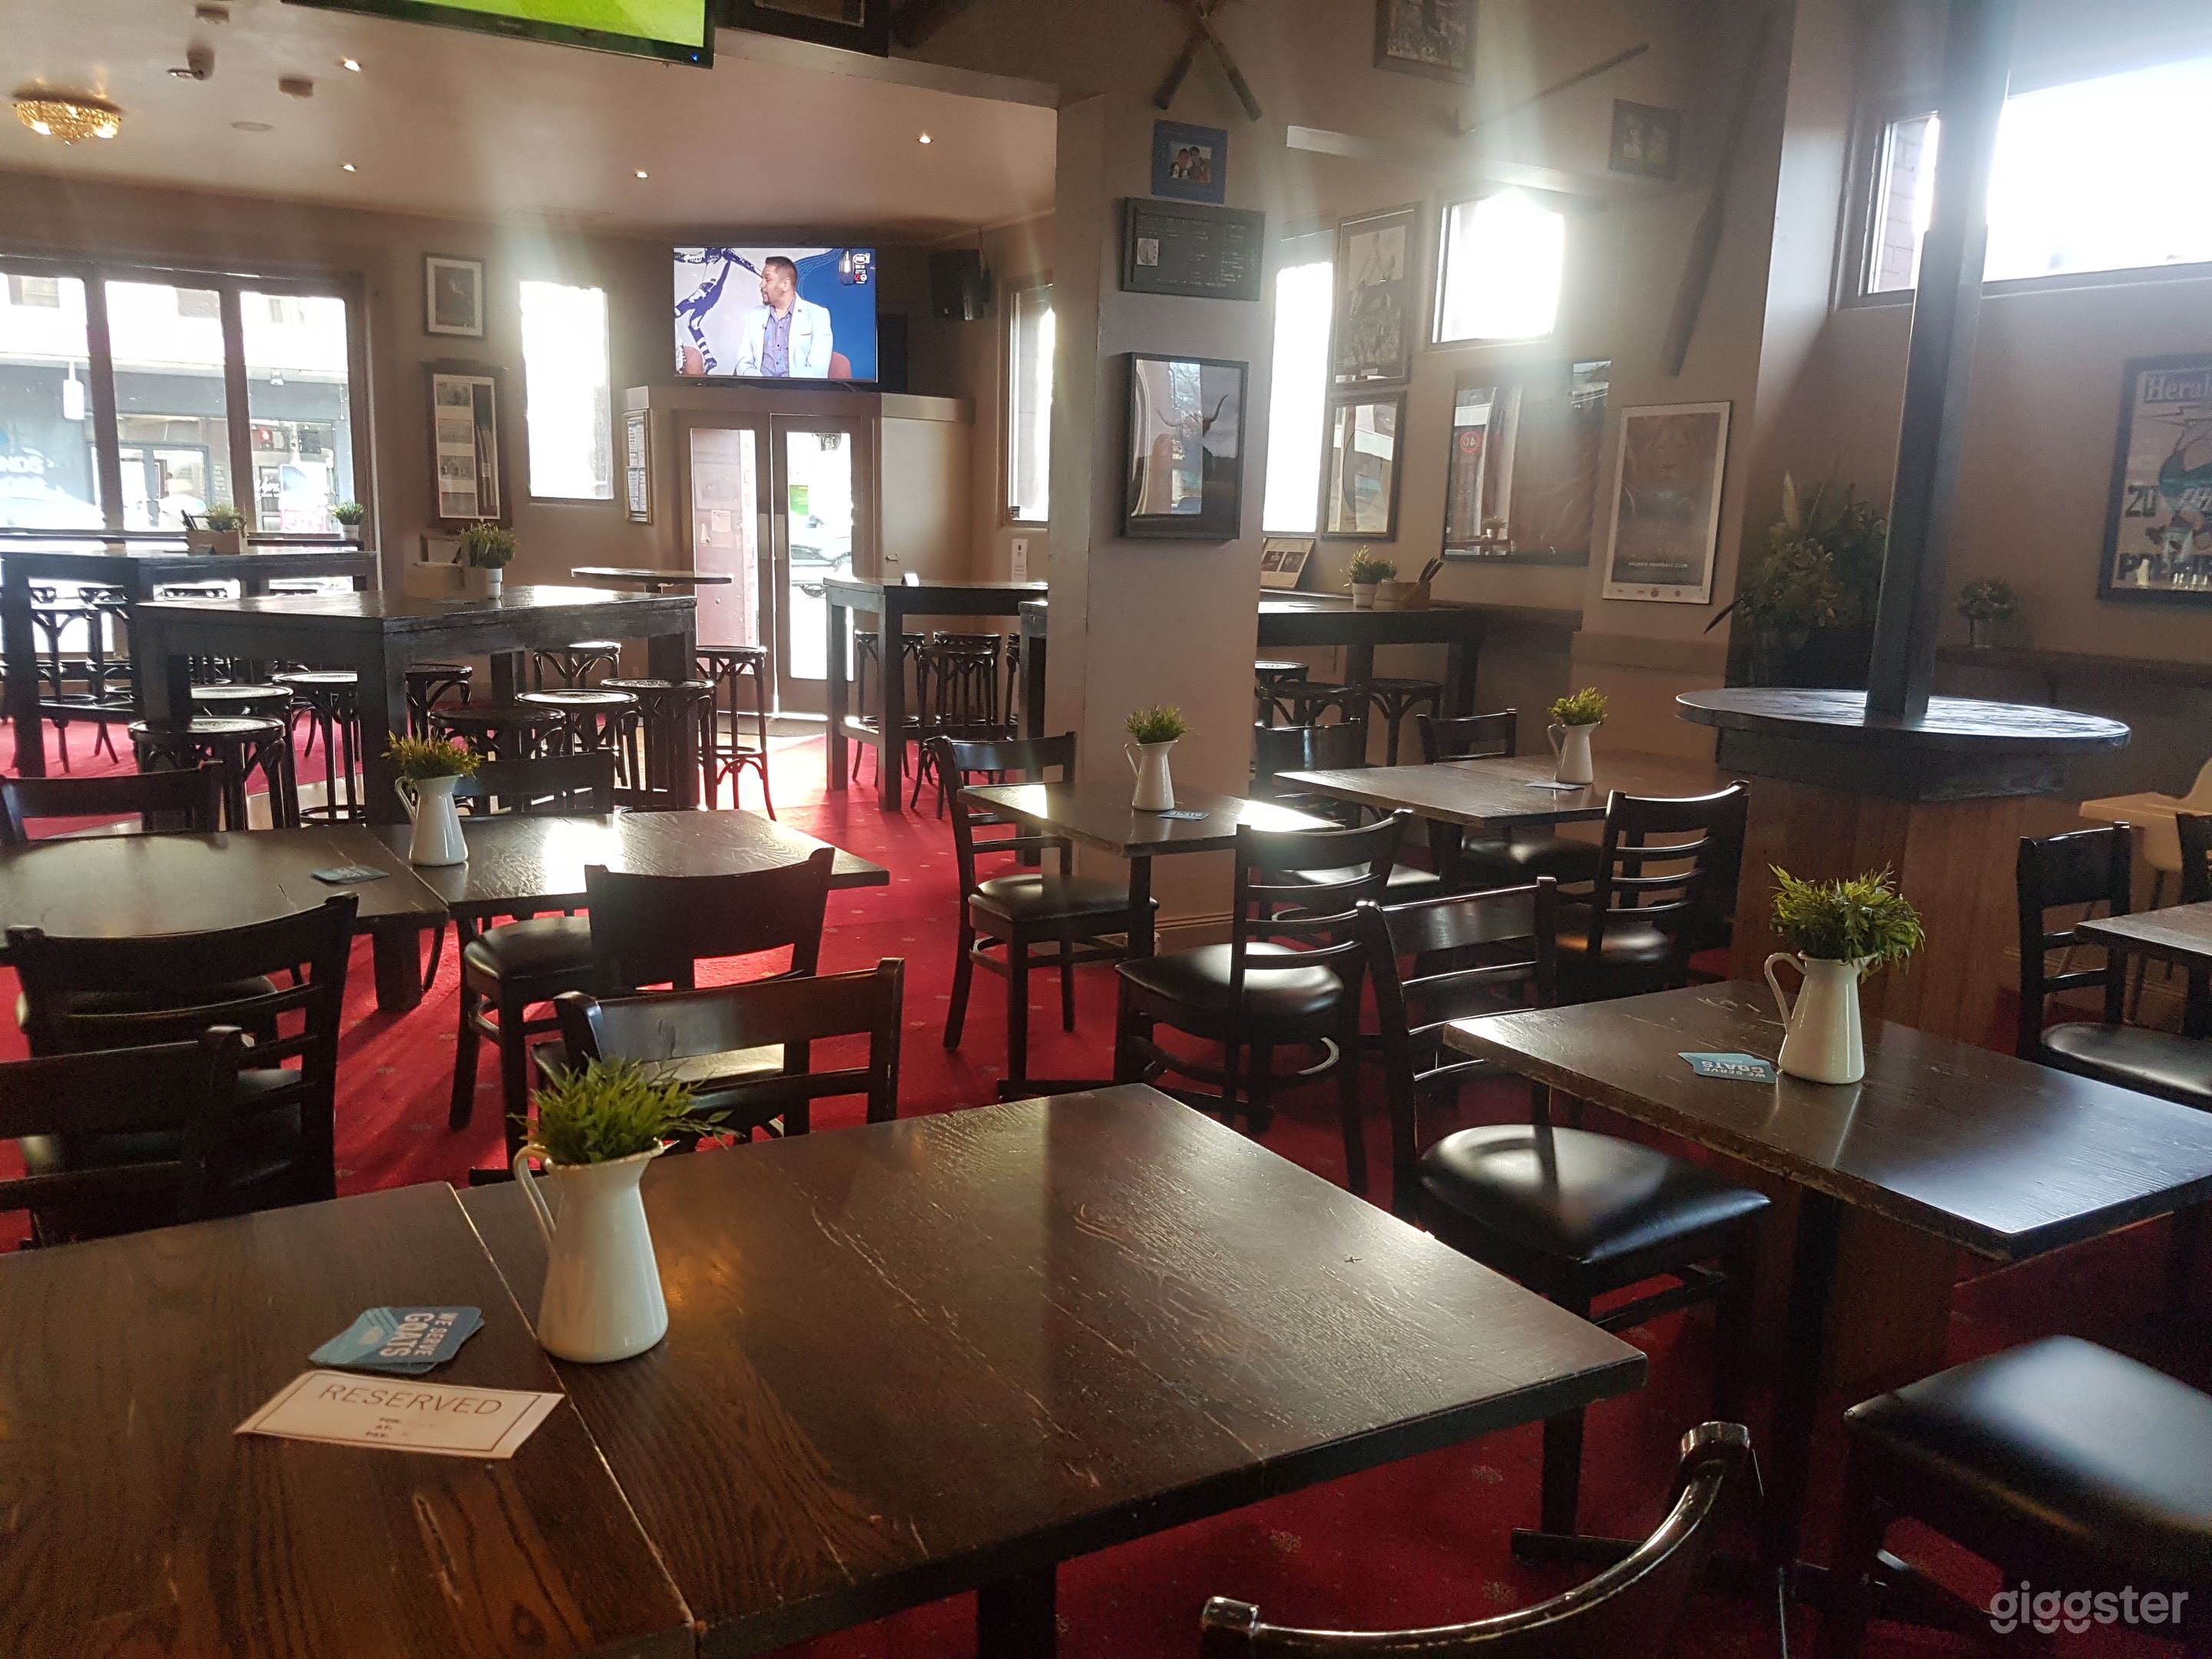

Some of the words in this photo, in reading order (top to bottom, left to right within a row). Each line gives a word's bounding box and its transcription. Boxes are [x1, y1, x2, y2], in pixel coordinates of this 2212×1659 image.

[1701, 1061, 1764, 1075] GOATS
[435, 1313, 459, 1326] WE
[380, 1313, 435, 1357] GOATS
[414, 1328, 447, 1356] SERVE
[320, 1385, 503, 1416] RESERVED
